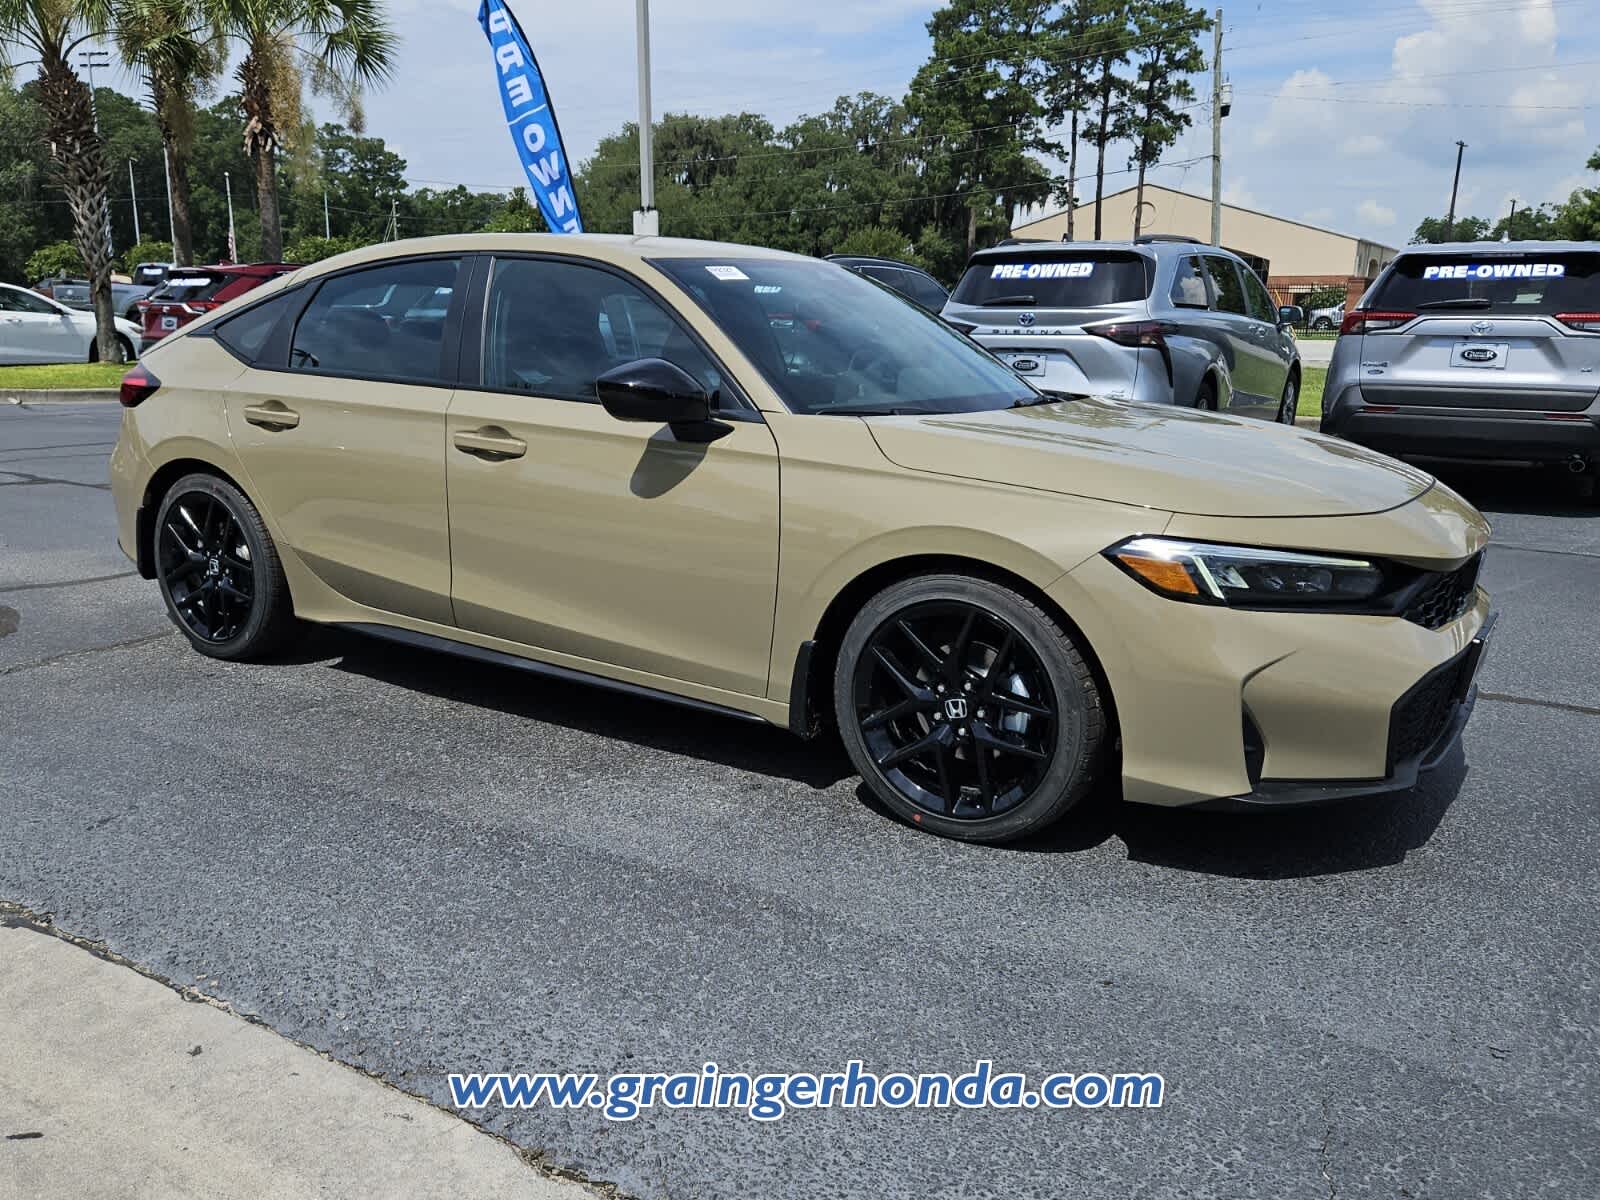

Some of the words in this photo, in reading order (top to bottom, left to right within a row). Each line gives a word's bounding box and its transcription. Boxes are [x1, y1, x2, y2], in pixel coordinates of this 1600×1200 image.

[990, 262, 1095, 279] PRE-OWNED
[1423, 264, 1565, 279] PRE-OWNED
[992, 328, 1062, 336] SIENNA
